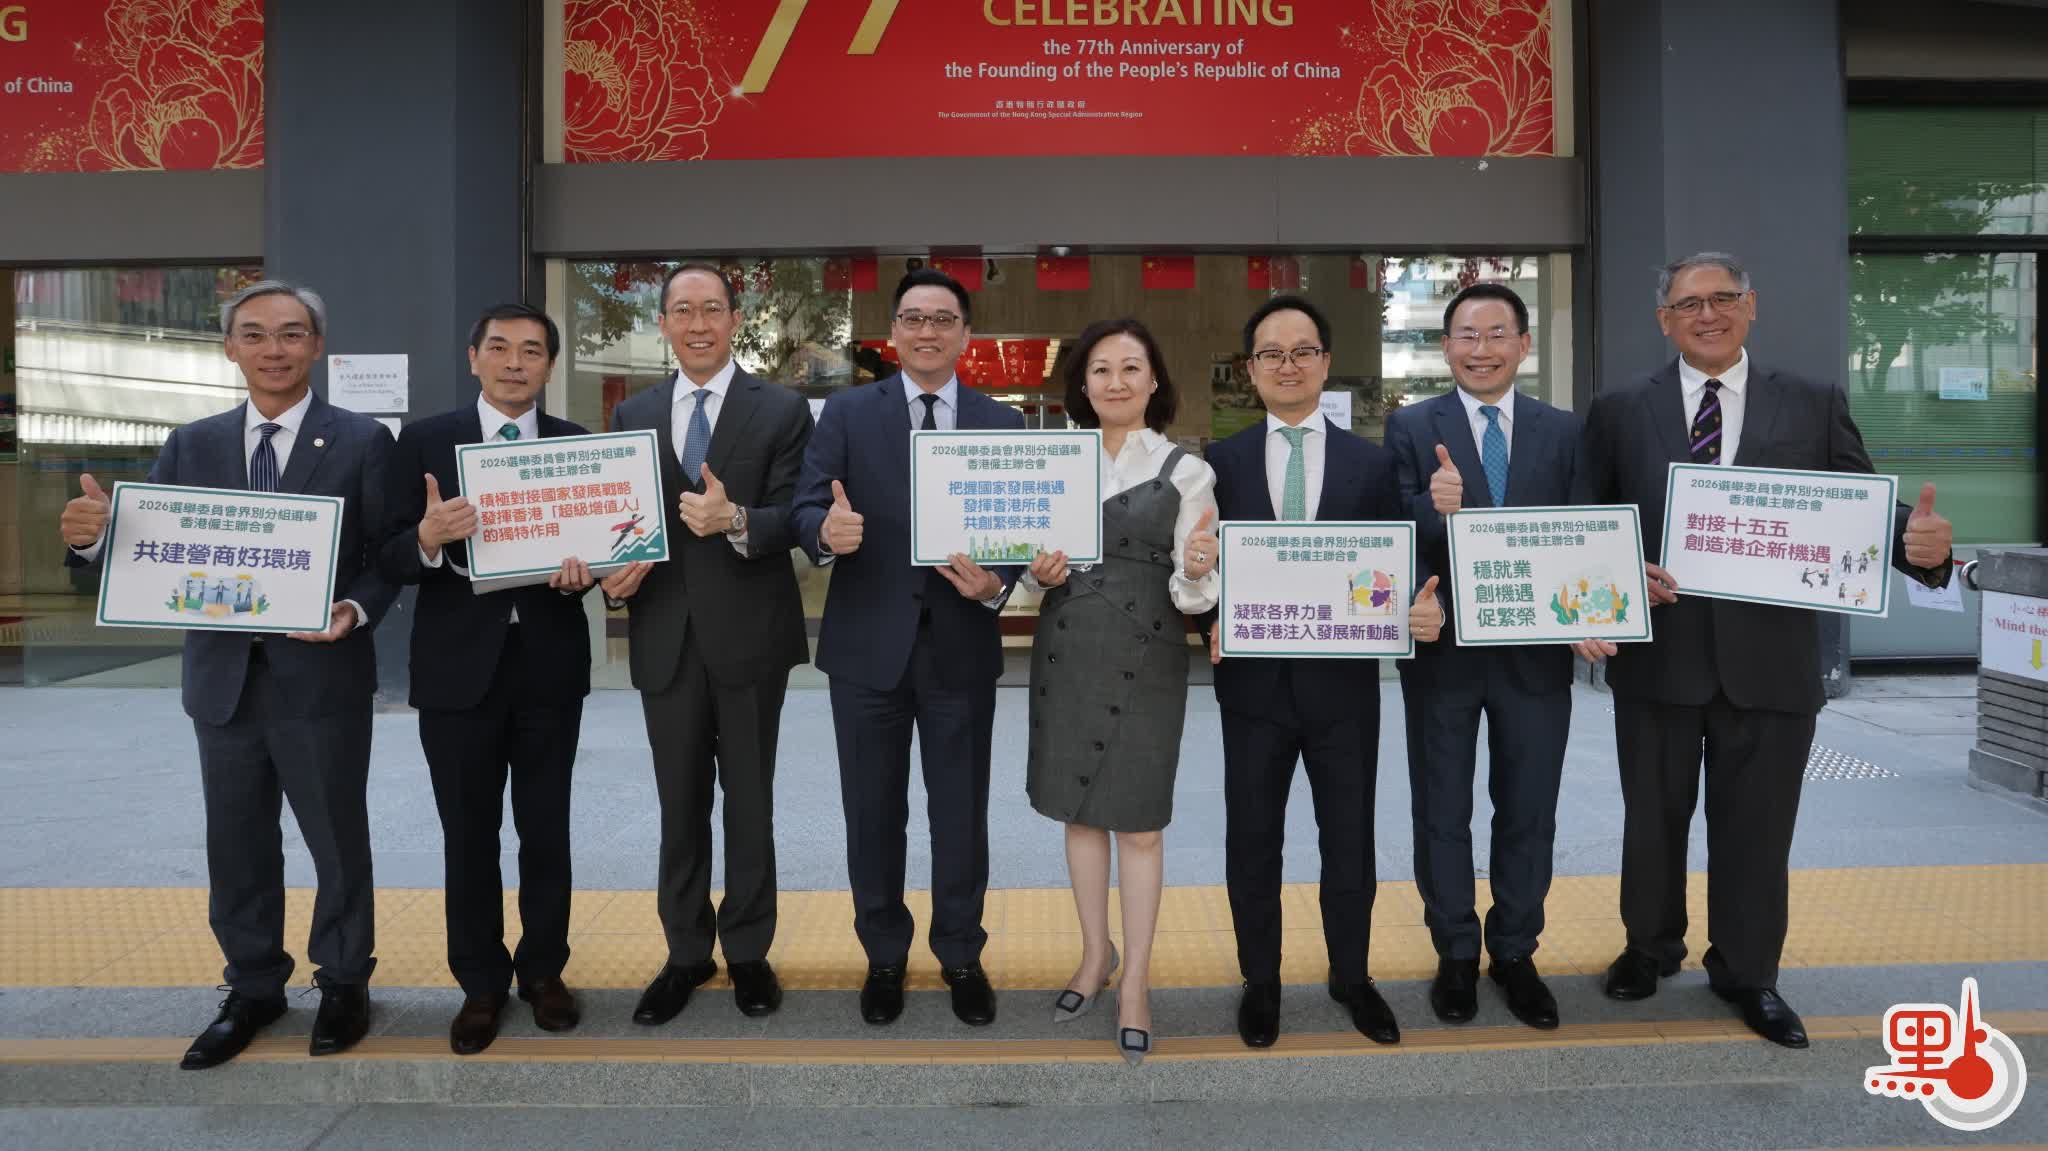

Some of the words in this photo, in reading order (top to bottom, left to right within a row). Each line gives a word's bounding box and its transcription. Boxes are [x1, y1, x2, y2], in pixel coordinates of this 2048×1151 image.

[1043, 39, 1071, 55] the
[1076, 39, 1114, 55] 77th
[1120, 39, 1221, 59] Anniversary
[1226, 39, 1244, 55] of
[944, 61, 973, 78] the
[978, 61, 1057, 81] Founding
[1063, 61, 1081, 78] of
[1086, 61, 1113, 78] the
[1119, 61, 1189, 81] People's
[1194, 61, 1266, 81] Republic
[1271, 61, 1289, 78] of
[1294, 61, 1341, 78] China
[4, 77, 22, 93] of
[27, 77, 73, 93] China
[480, 446, 637, 468] 2026選舉委員會界別分組選舉
[932, 444, 1081, 457] 2026選舉委員會界別分組選舉
[519, 463, 602, 480] 香港僱主聯合會
[967, 458, 1046, 471] 香港僱主聯合會
[479, 481, 632, 508] 積極對接國家發展戰略
[948, 480, 1065, 496] 把握國家發展機遇
[1691, 479, 1869, 501] 2026選舉委員會界別分組選舉
[138, 499, 318, 522] 2026選舉委員會界別分組選舉
[963, 498, 1051, 513] 發揮香港所長
[1728, 494, 1824, 512] 香港僱主聯合會
[179, 516, 276, 534] 香港僱主聯合會
[963, 515, 1051, 530] 共創繁榮未來
[1469, 520, 1619, 534] 2026選舉委員會界別分組選舉
[1686, 513, 1790, 538] 對接十五五
[483, 523, 560, 543] 的獨特作用
[1241, 536, 1394, 548] 2026選舉委員會界別分組選舉
[1505, 533, 1586, 548] 香港僱主聯合會
[133, 540, 312, 571] 共建營商好環境
[1276, 550, 1359, 562] 香港僱主聯合會
[1684, 533, 1832, 564] 創造港企新機遇
[1472, 559, 1532, 580] 穩就業
[1474, 583, 1535, 604] 創機遇
[1233, 604, 1333, 621] 凝聚各界力量
[1476, 607, 1537, 628] 促繁榮
[1233, 623, 1400, 641] 為香港注入發展新動能
[1994, 617, 2025, 633] Mind
